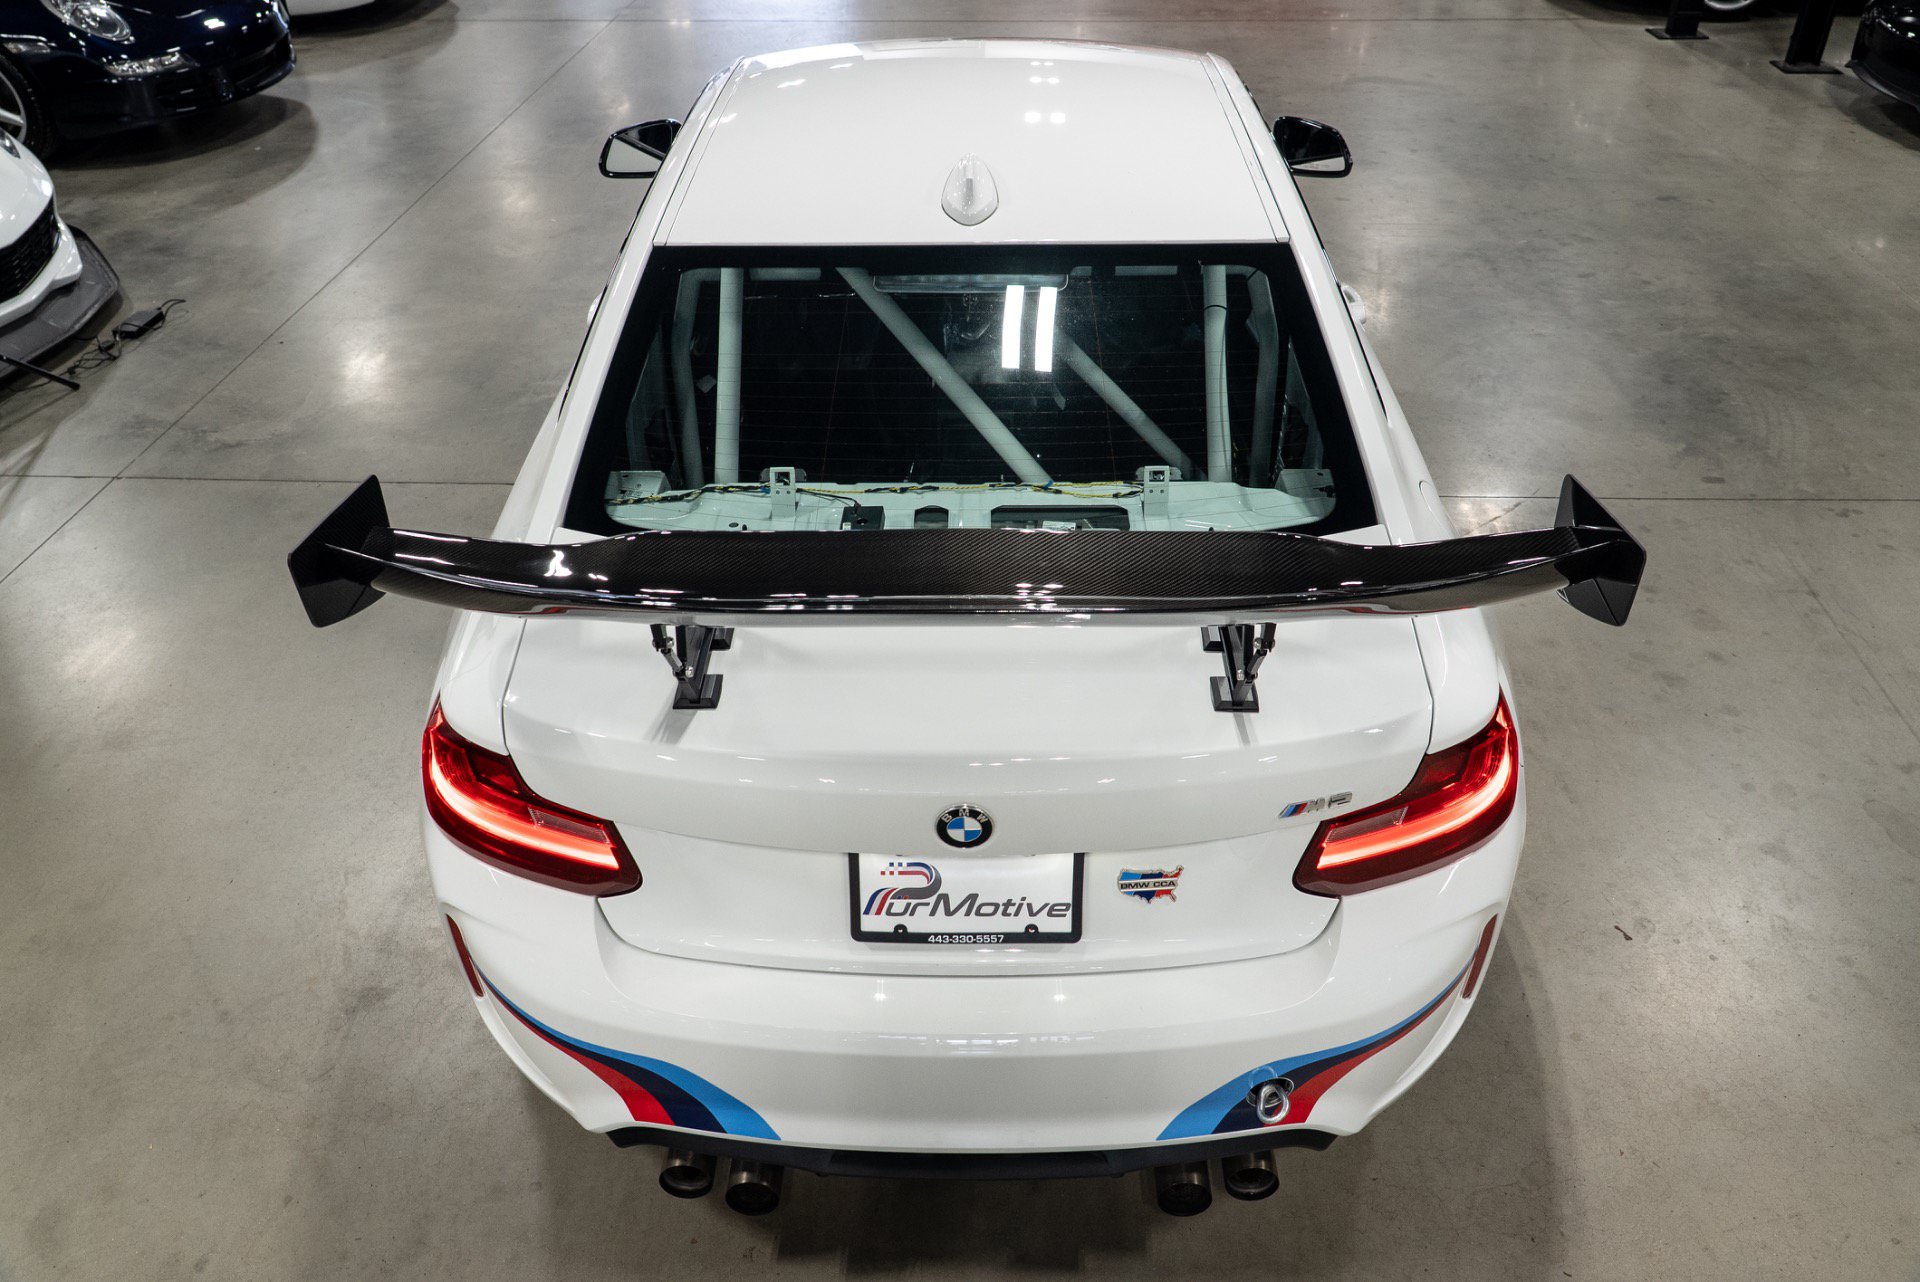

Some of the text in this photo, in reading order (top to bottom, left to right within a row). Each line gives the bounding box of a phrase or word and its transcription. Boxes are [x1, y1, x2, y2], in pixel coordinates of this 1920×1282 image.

[941, 808, 989, 823] BMW
[1120, 880, 1176, 890] BMW CCA
[928, 934, 1005, 944] 443-330-5557
